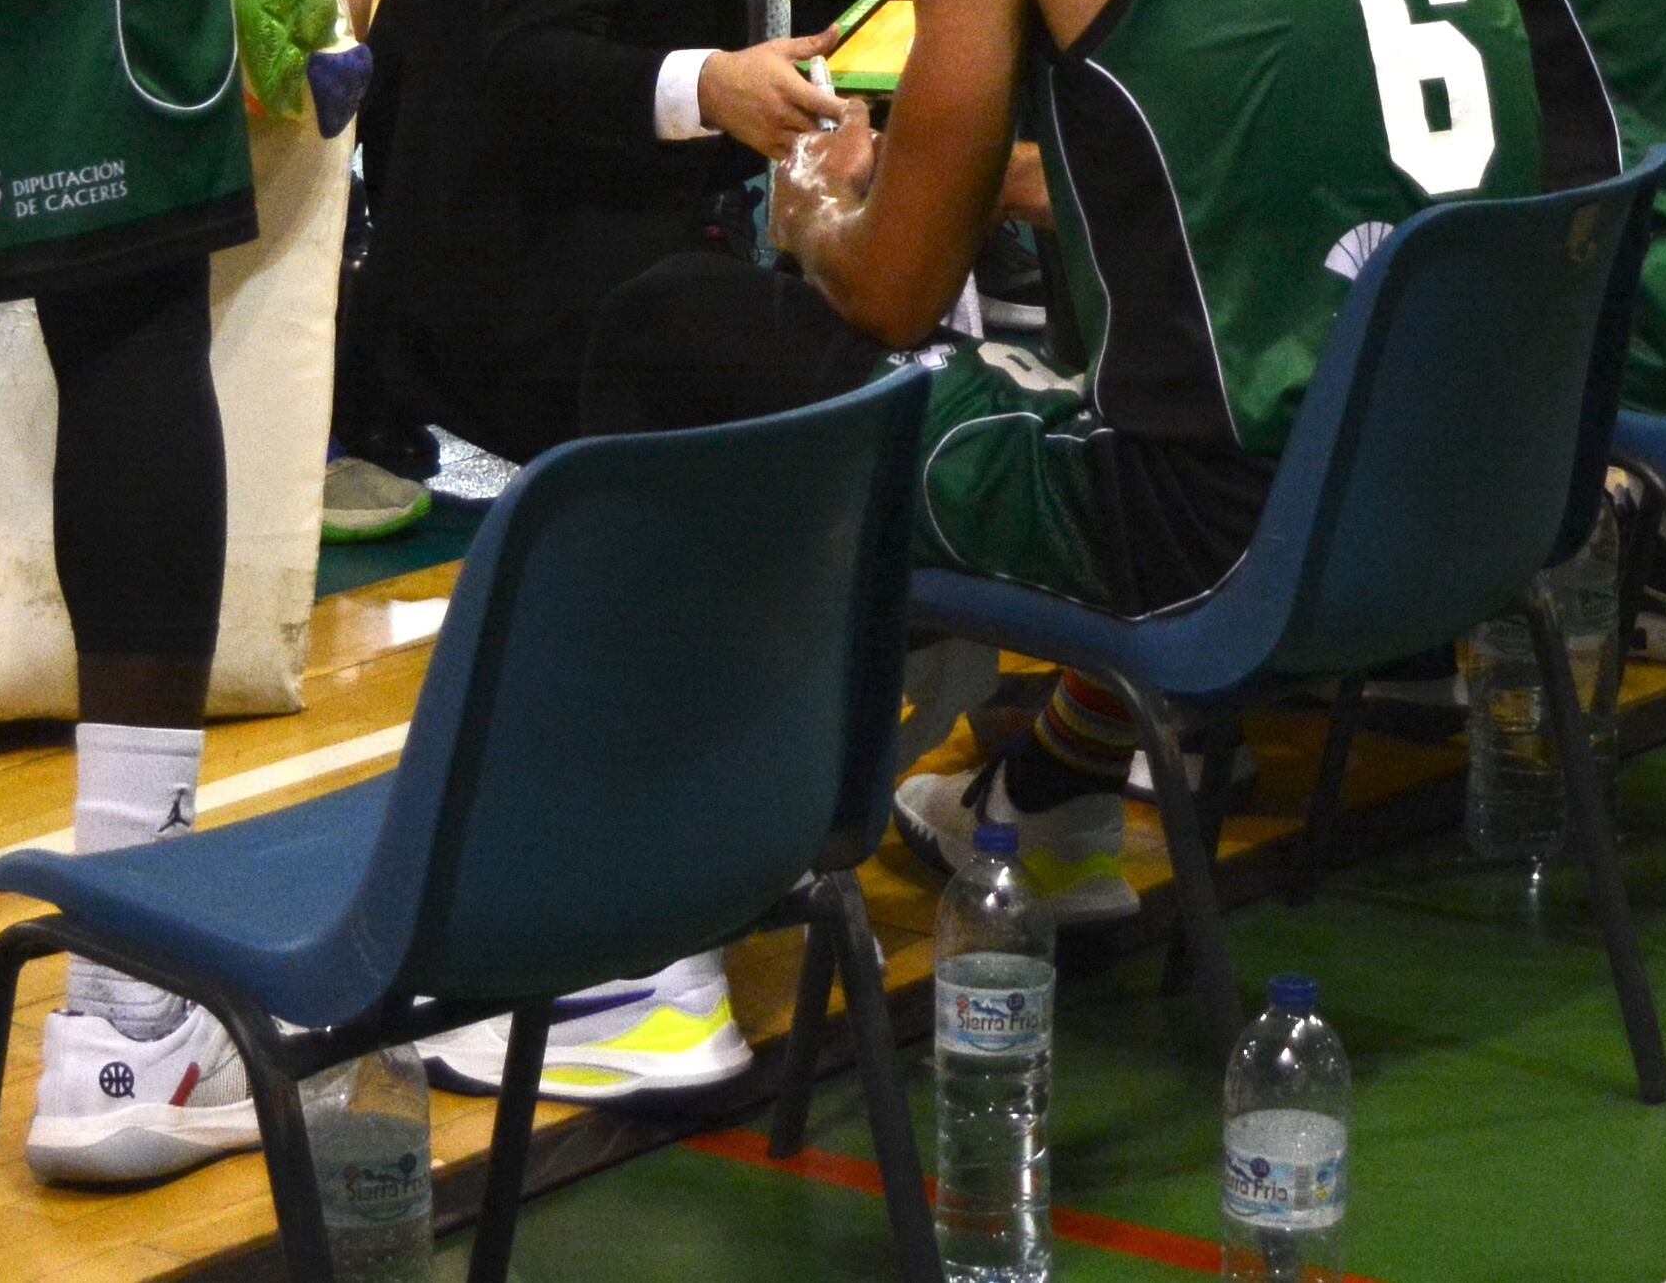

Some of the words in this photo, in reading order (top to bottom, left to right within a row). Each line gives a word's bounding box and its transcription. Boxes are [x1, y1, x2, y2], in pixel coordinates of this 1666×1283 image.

[13, 159, 126, 198] DIPUTACIÓN
[14, 197, 39, 219] DE
[956, 1009, 1006, 1031] Sierra
